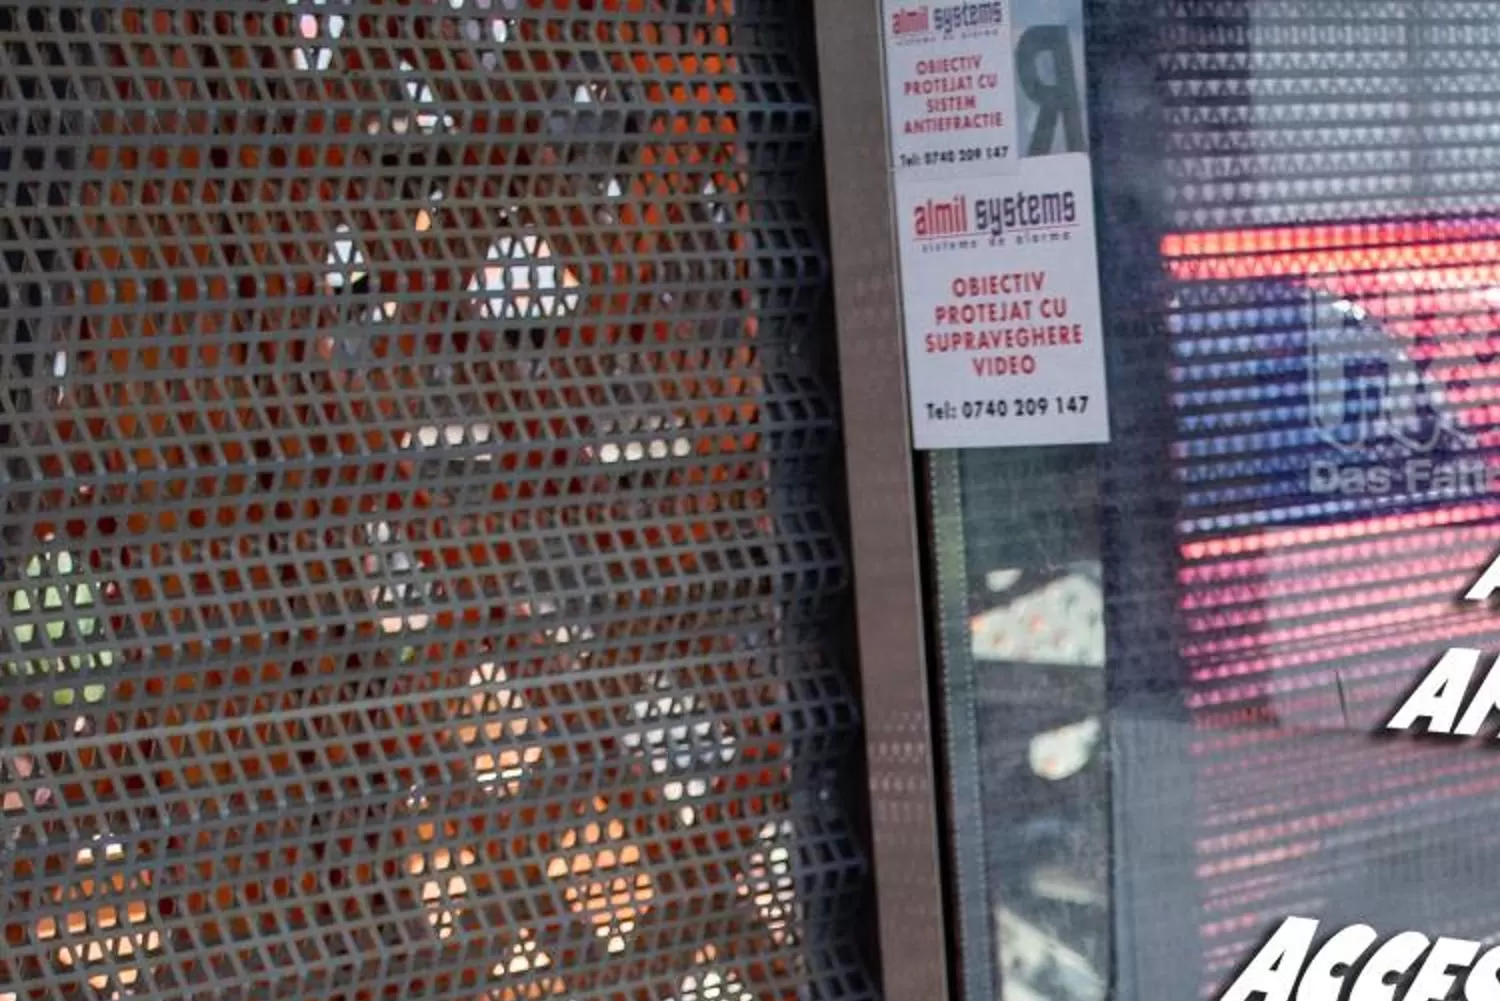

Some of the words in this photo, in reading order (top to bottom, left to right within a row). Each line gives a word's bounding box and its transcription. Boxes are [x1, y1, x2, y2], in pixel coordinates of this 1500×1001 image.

[933, 1, 1003, 33] systems
[916, 54, 983, 76] OBIECTIV
[904, 75, 973, 96] PROTEJAT
[977, 73, 999, 90] CU
[926, 95, 977, 113] SISTEM
[904, 111, 1004, 135] ANTIEFRACTIE
[985, 145, 1009, 159] 147
[913, 194, 968, 236] almil
[974, 190, 1077, 236] systems
[951, 271, 1046, 298] OBIECTIV
[934, 299, 1033, 325] PROTEJAT
[1039, 297, 1068, 319] CU
[924, 323, 1084, 353] SUPRAVEGHERE
[972, 354, 1037, 377] VIDEO
[926, 401, 958, 421] Tel:
[961, 399, 1009, 419] 0740
[1013, 397, 1049, 417] 209
[1056, 395, 1090, 414] 147
[1309, 459, 1392, 494] Das
